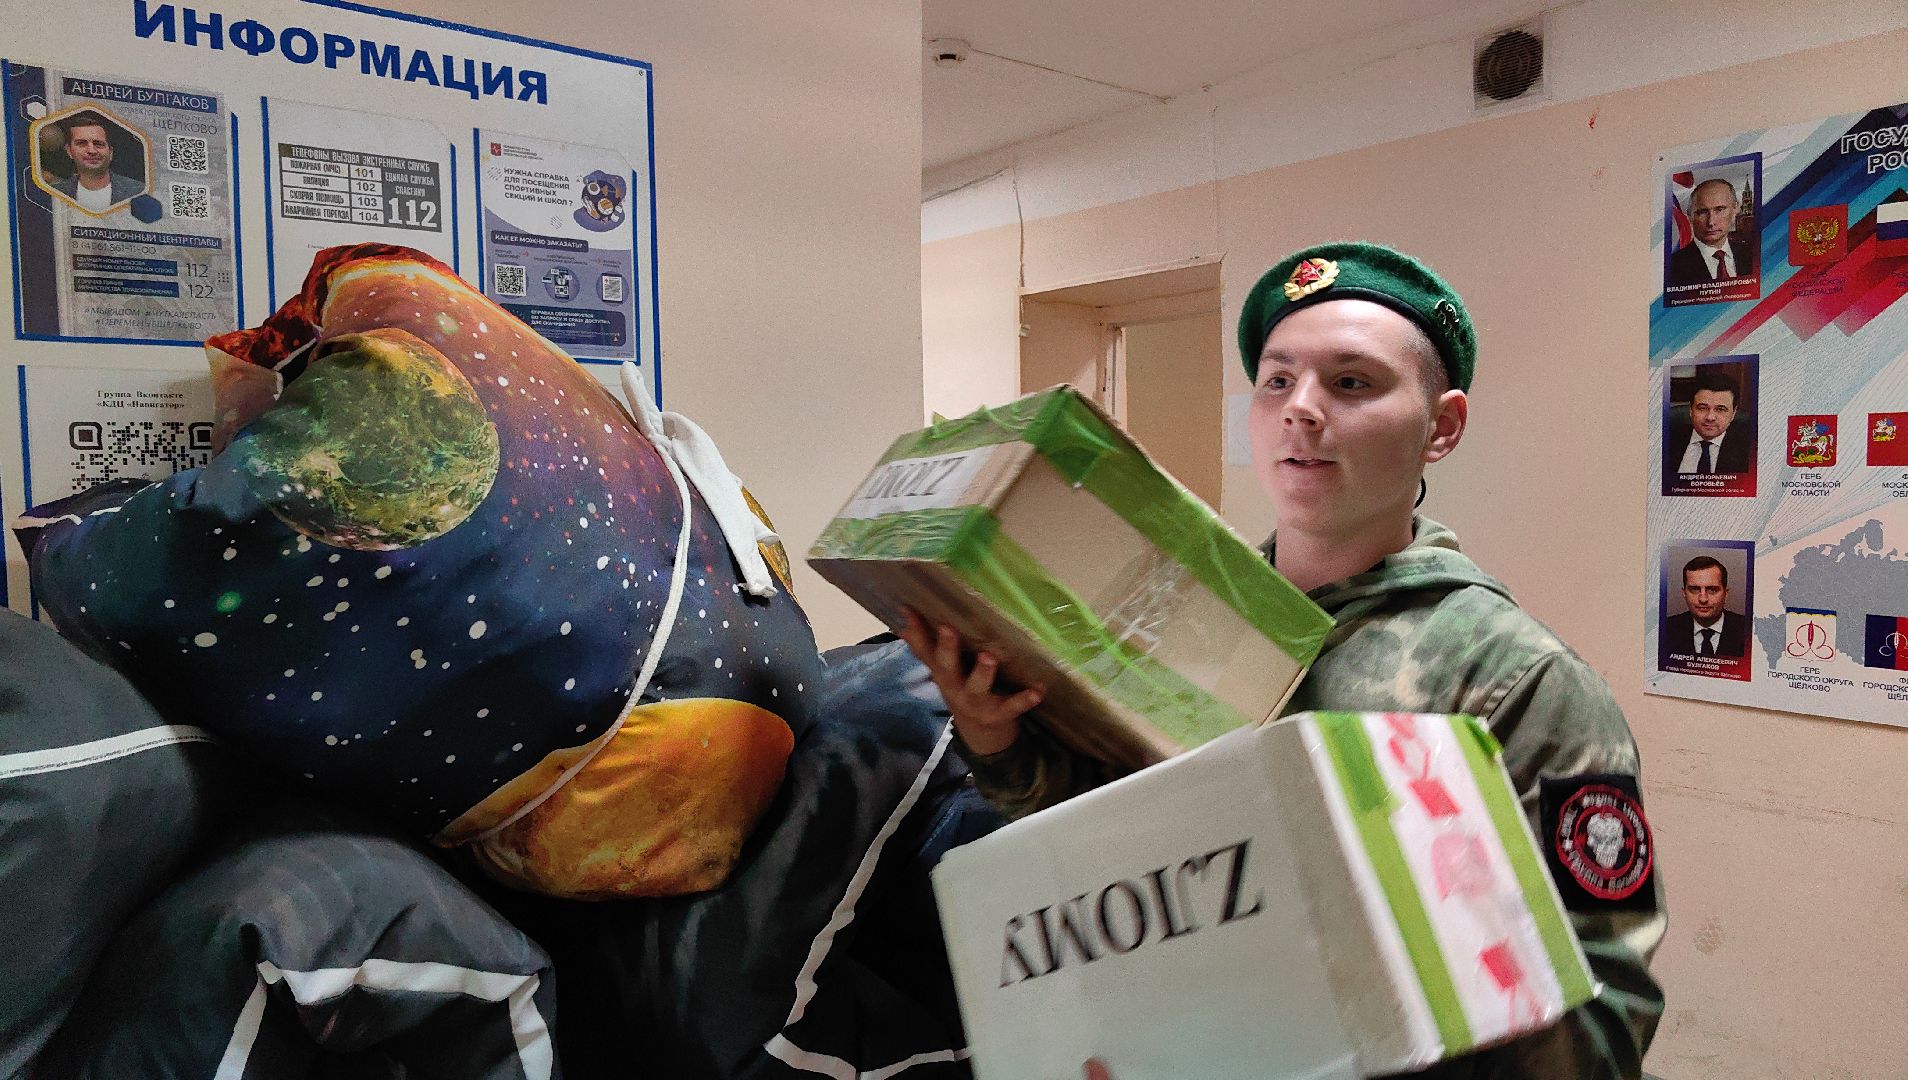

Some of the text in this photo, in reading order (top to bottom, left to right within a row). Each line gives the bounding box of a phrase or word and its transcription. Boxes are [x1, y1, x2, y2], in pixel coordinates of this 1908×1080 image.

[134, 0, 548, 105] ИНФОРМАЦИЯ
[71, 81, 210, 110] АНДРЕЙ БУЛГАКОВ
[1841, 124, 1908, 154] ГОСУ
[291, 146, 430, 172] ТЕЛЕФОНЫ ВЫЗОВА ЭКСТРЕННЫХ СЛУЖБ
[290, 160, 322, 172] ПОЖАРНАЯ
[355, 167, 374, 178] 101
[504, 168, 570, 183] НУЖНА СПРАВКА
[302, 176, 376, 192] ПОЛИЦИЯ 102
[385, 172, 435, 187] ЕДИНАЯ СЛУЖБА
[504, 176, 570, 190] ДЛЯ ПОСЕЩЕНИЯ
[395, 186, 426, 198] СПАСЕНИЯ
[504, 184, 557, 197] СПОРТИВНЫХ
[289, 190, 378, 207] СКОРАЯ ПОМОЩЬ 103
[504, 192, 536, 203] СЕКЦИЙ
[544, 196, 568, 206] ШКОЛ
[285, 205, 322, 218] АВАРИЙНАЯ
[359, 211, 379, 222] 104
[388, 198, 438, 228] 112
[73, 228, 220, 248] СИТУАЦИОННЫЙ ЦЕНТР ГЛАВЫ
[495, 234, 510, 243] КАК
[519, 236, 546, 245] МОЖНО
[185, 263, 209, 278] 112
[187, 284, 214, 299] 122
[1666, 278, 1757, 293] ВЛАДИМИР ВЛАДИМИРОВИЧ
[1699, 288, 1722, 296] ПУТИН
[1791, 286, 1843, 298] ФЕДЕРАЦИИ
[97, 390, 184, 399] Группа Вконтакте
[96, 400, 185, 409] «КДЦ «Навигатор»
[1679, 473, 1705, 481] АНДРЕЙ
[1781, 480, 1841, 488] МОСКОВСКОЙ
[1791, 489, 1830, 497] ОБЛАСТИ
[1669, 653, 1739, 666] АНДРЕЙ АЛЕКСЕЕВИЧ
[1686, 661, 1720, 670] БУЛГАКОВ
[1800, 666, 1821, 675] ГЕРБ
[1767, 671, 1855, 687] ГОРОДСКОГО ОКРУГА
